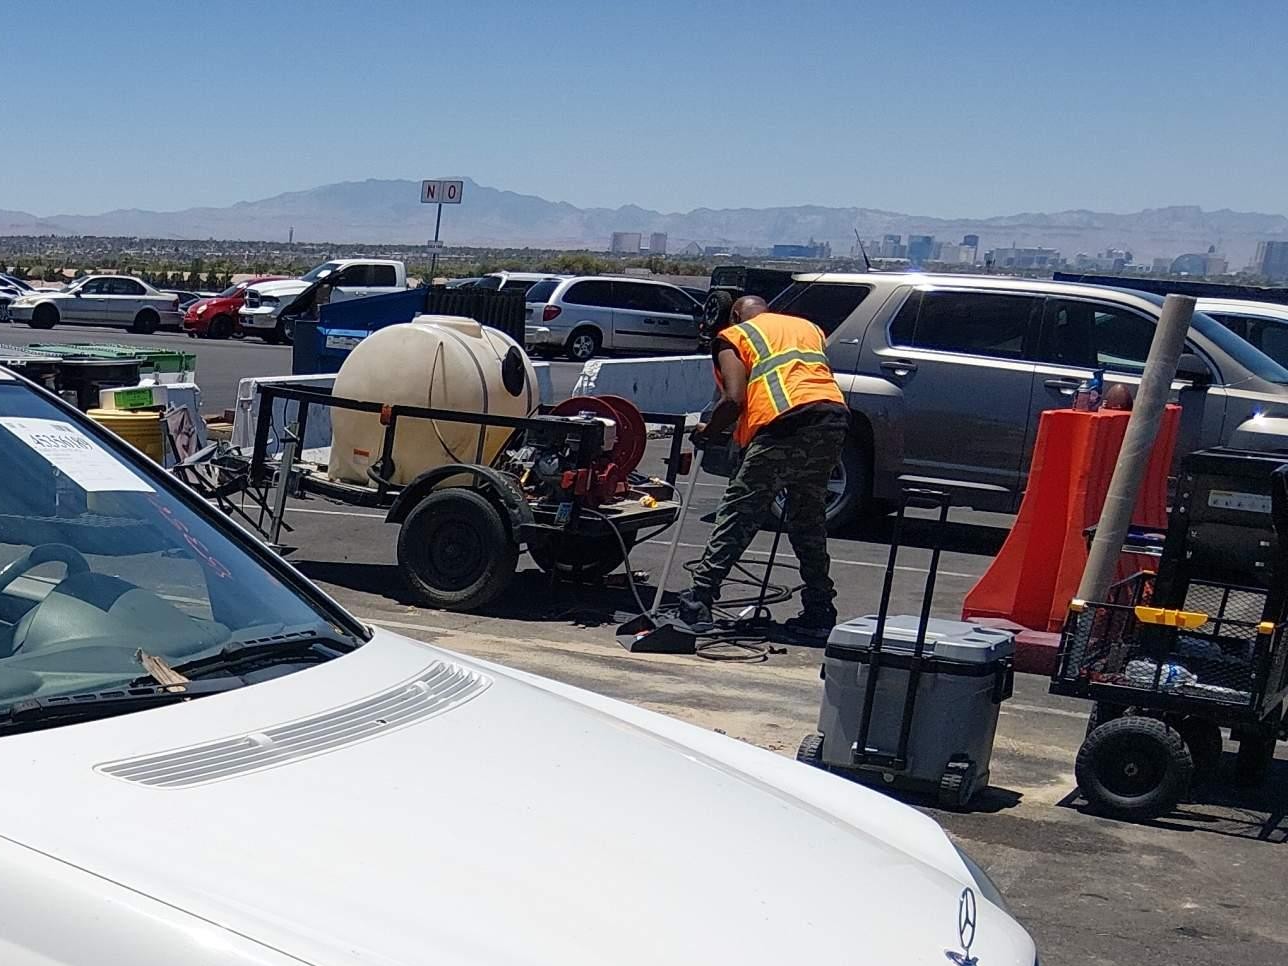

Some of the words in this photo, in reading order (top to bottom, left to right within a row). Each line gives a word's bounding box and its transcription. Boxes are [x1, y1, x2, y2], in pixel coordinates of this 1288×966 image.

[427, 184, 435, 199] N
[448, 184, 456, 199] O
[29, 434, 94, 451] 45356189
